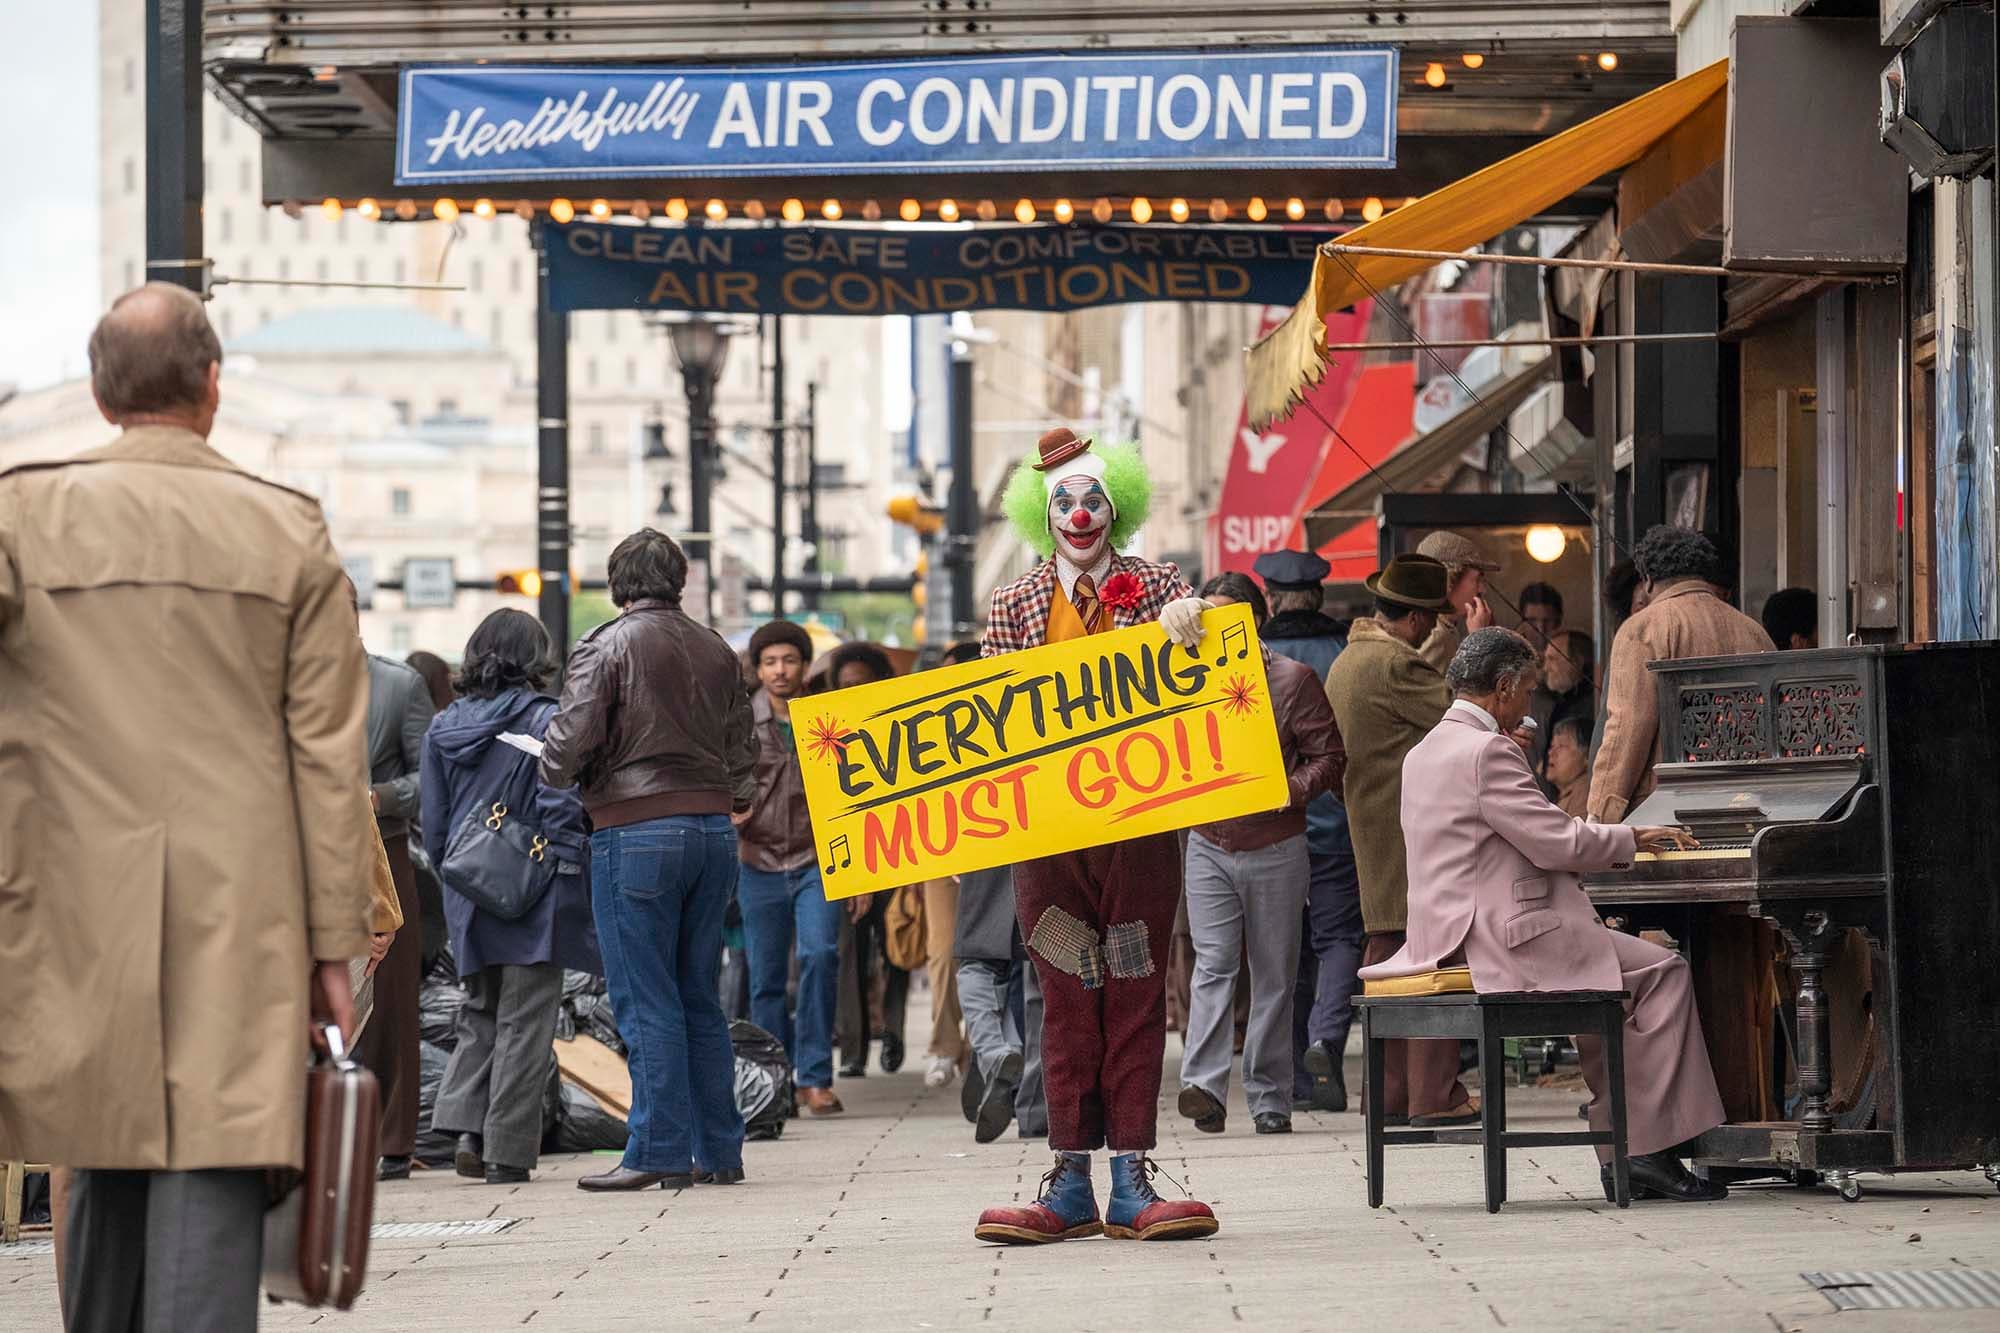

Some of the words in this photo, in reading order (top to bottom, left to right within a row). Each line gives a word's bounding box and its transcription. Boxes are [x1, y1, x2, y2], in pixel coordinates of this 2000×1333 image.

[427, 77, 700, 165] Healthfully
[708, 80, 834, 149] AIR
[856, 72, 1367, 146] CONDITIONED
[568, 229, 732, 265] CLEAN
[783, 235, 908, 269] SAFE
[958, 234, 1314, 268] COMFORTABLE
[649, 272, 760, 308] AIR
[781, 265, 1251, 313] CONDITIONED
[837, 641, 1210, 797] EVERYTHING
[864, 765, 1039, 874] MUST
[1066, 710, 1224, 809] GO!!
